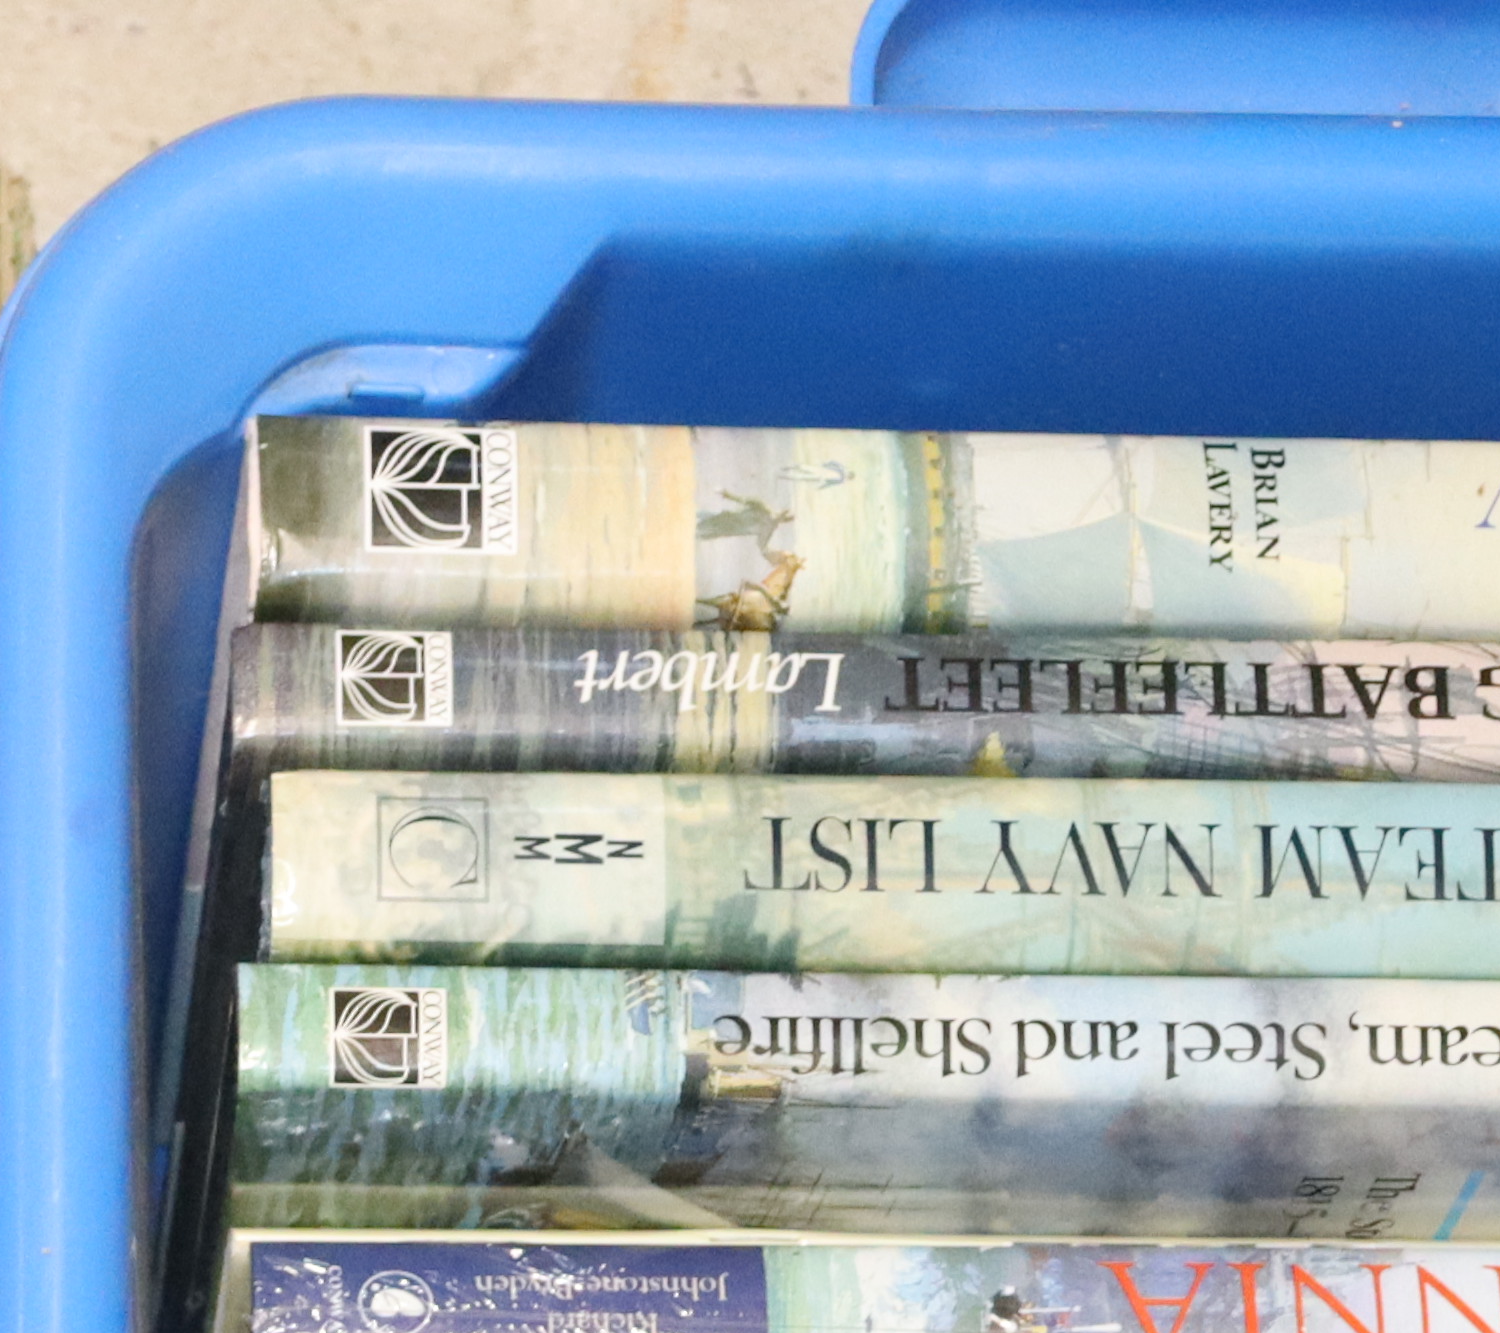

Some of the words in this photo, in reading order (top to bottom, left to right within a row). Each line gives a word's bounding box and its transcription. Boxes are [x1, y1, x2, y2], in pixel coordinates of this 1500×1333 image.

[1203, 443, 1237, 563] LAVERY
[1251, 449, 1285, 557] BRIAN
[575, 642, 842, 722] Lambert
[884, 654, 1450, 720] BATTLEFLEET
[746, 818, 936, 891] LIST
[998, 821, 1218, 896] NAVY
[712, 1011, 992, 1077] Shellfire
[1014, 1020, 1138, 1077] and
[1165, 1022, 1326, 1080] Steel
